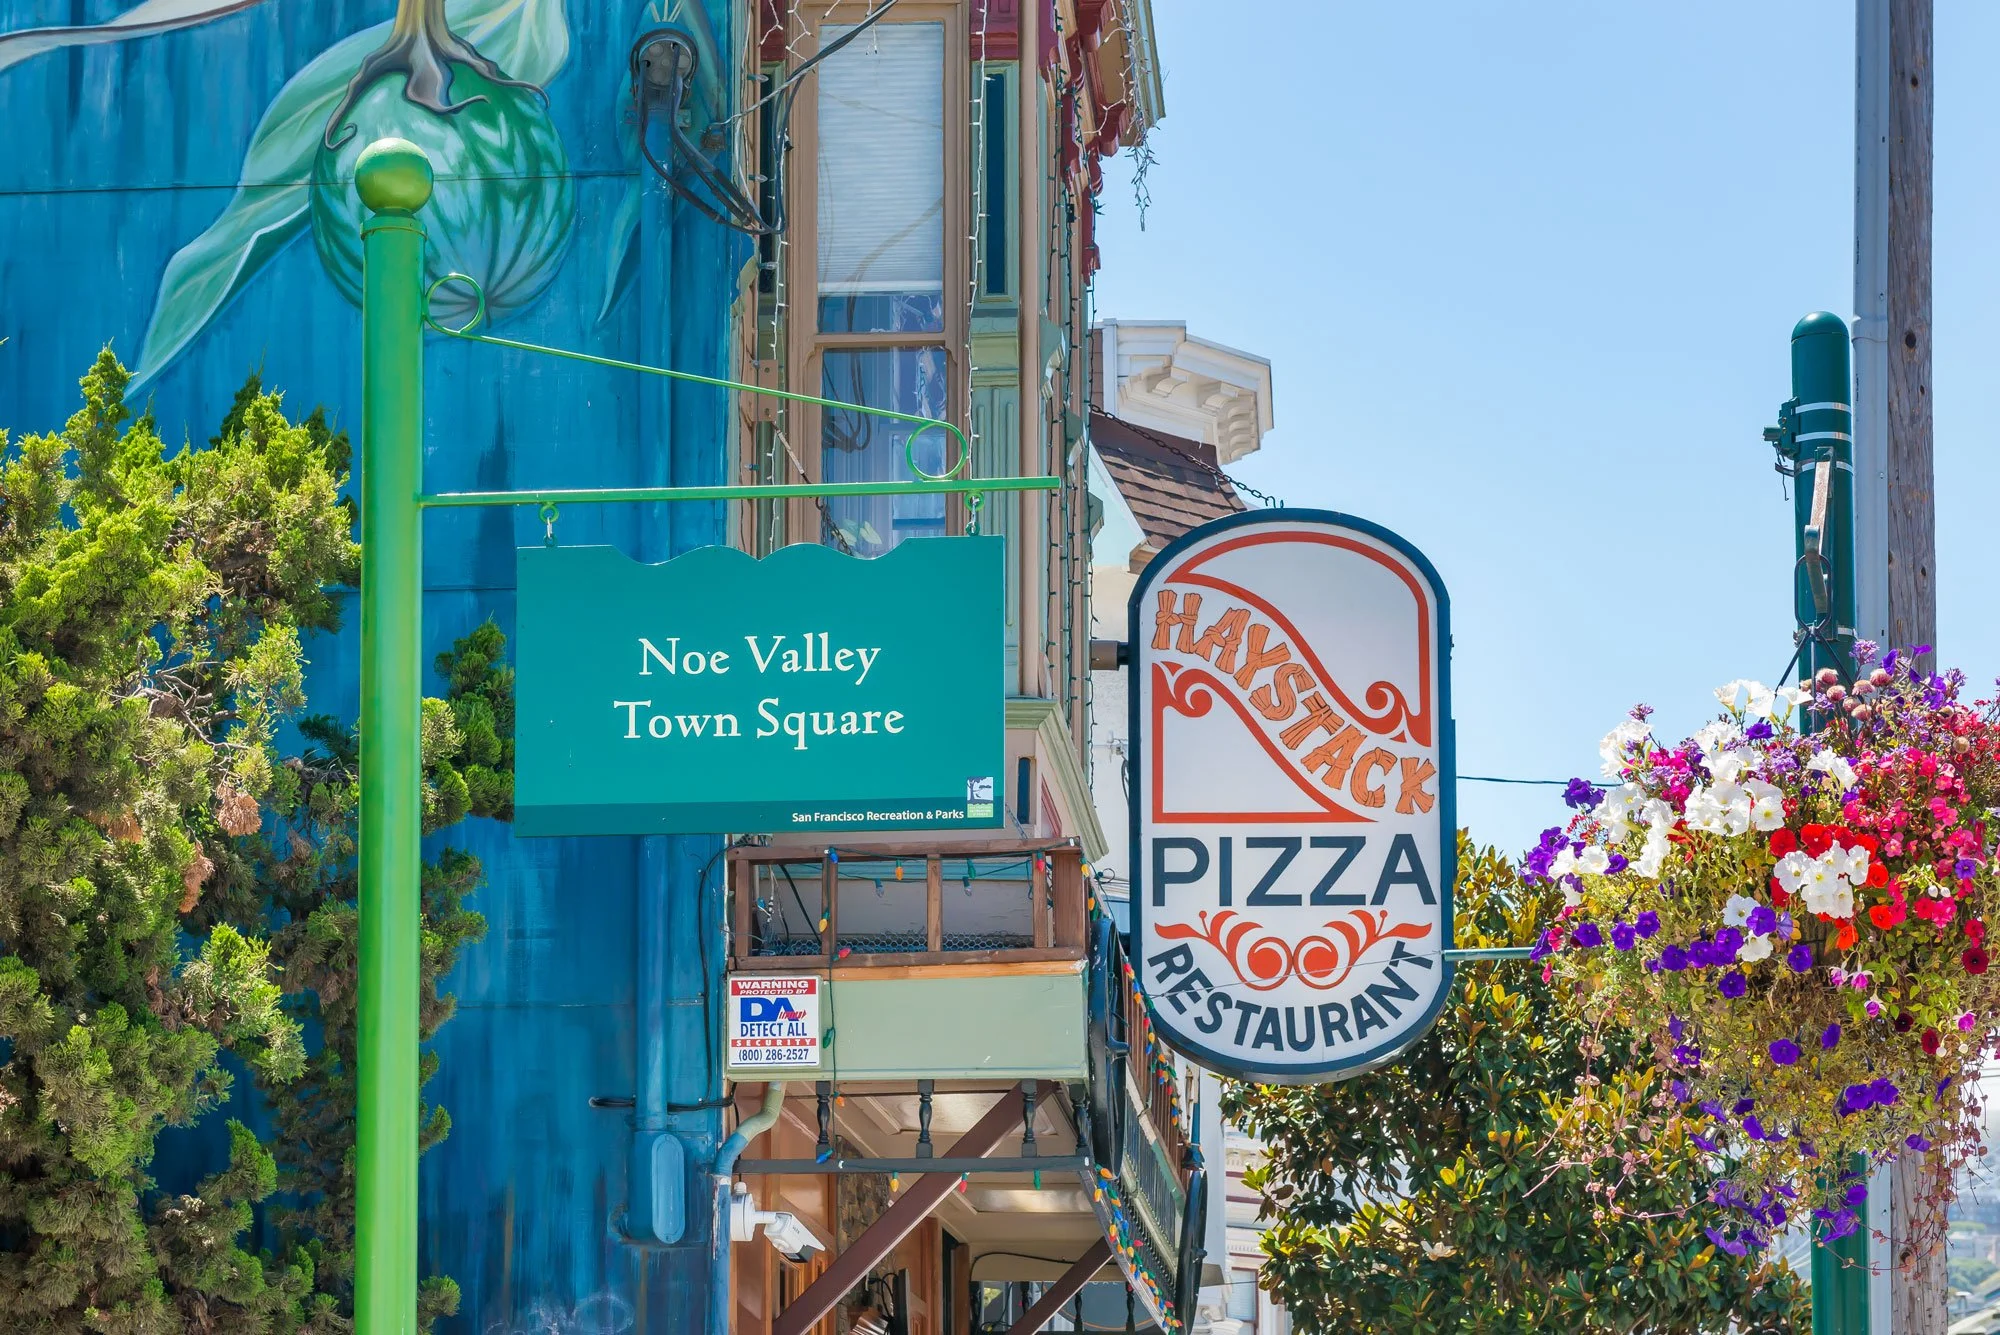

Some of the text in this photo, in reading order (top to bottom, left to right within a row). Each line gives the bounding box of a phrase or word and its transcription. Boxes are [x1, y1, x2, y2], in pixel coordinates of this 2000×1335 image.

[638, 632, 881, 686] Noe Valley
[613, 697, 905, 750] Town Square
[1151, 589, 1437, 814] HAYSTACK
[792, 812, 812, 822] San
[814, 811, 864, 822] Francisco
[866, 810, 924, 821] Recreation
[926, 811, 934, 820] &
[935, 809, 964, 819] Parks
[1152, 833, 1437, 907] PIZZA
[738, 980, 808, 988] WARNING
[1147, 940, 1434, 1051] RESTAURANT
[738, 1048, 809, 1062] (800) 286-2527
[740, 1022, 808, 1037] DETECT ALL
